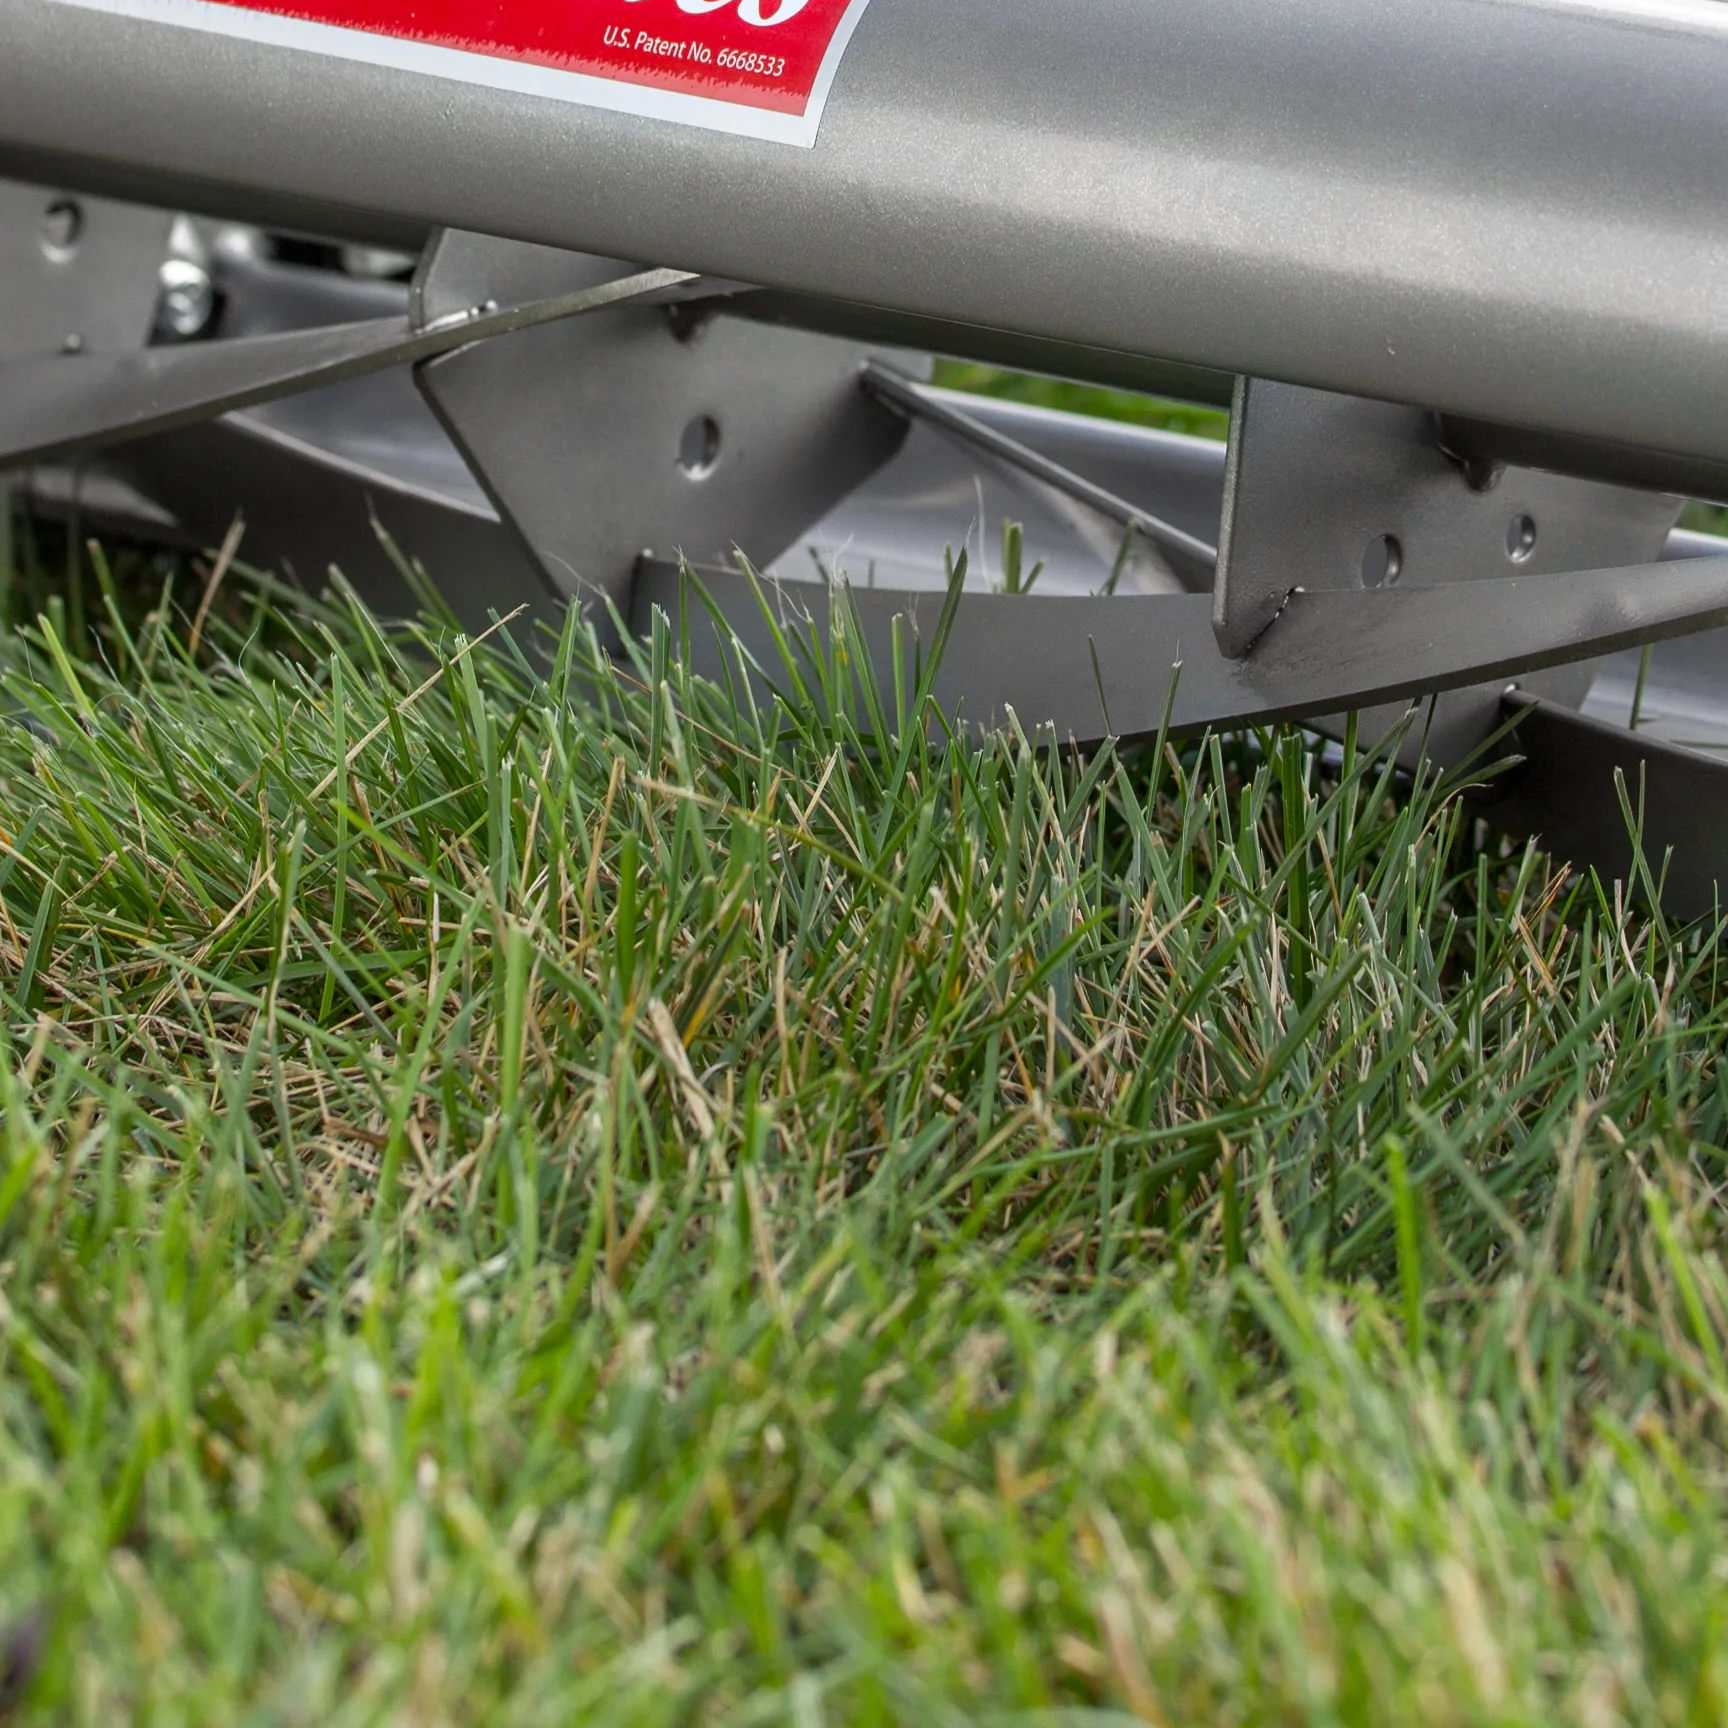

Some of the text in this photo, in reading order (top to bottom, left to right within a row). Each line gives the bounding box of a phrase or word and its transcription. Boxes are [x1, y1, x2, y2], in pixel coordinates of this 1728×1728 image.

[603, 25, 786, 77] U.S. Patent No. 6668533
